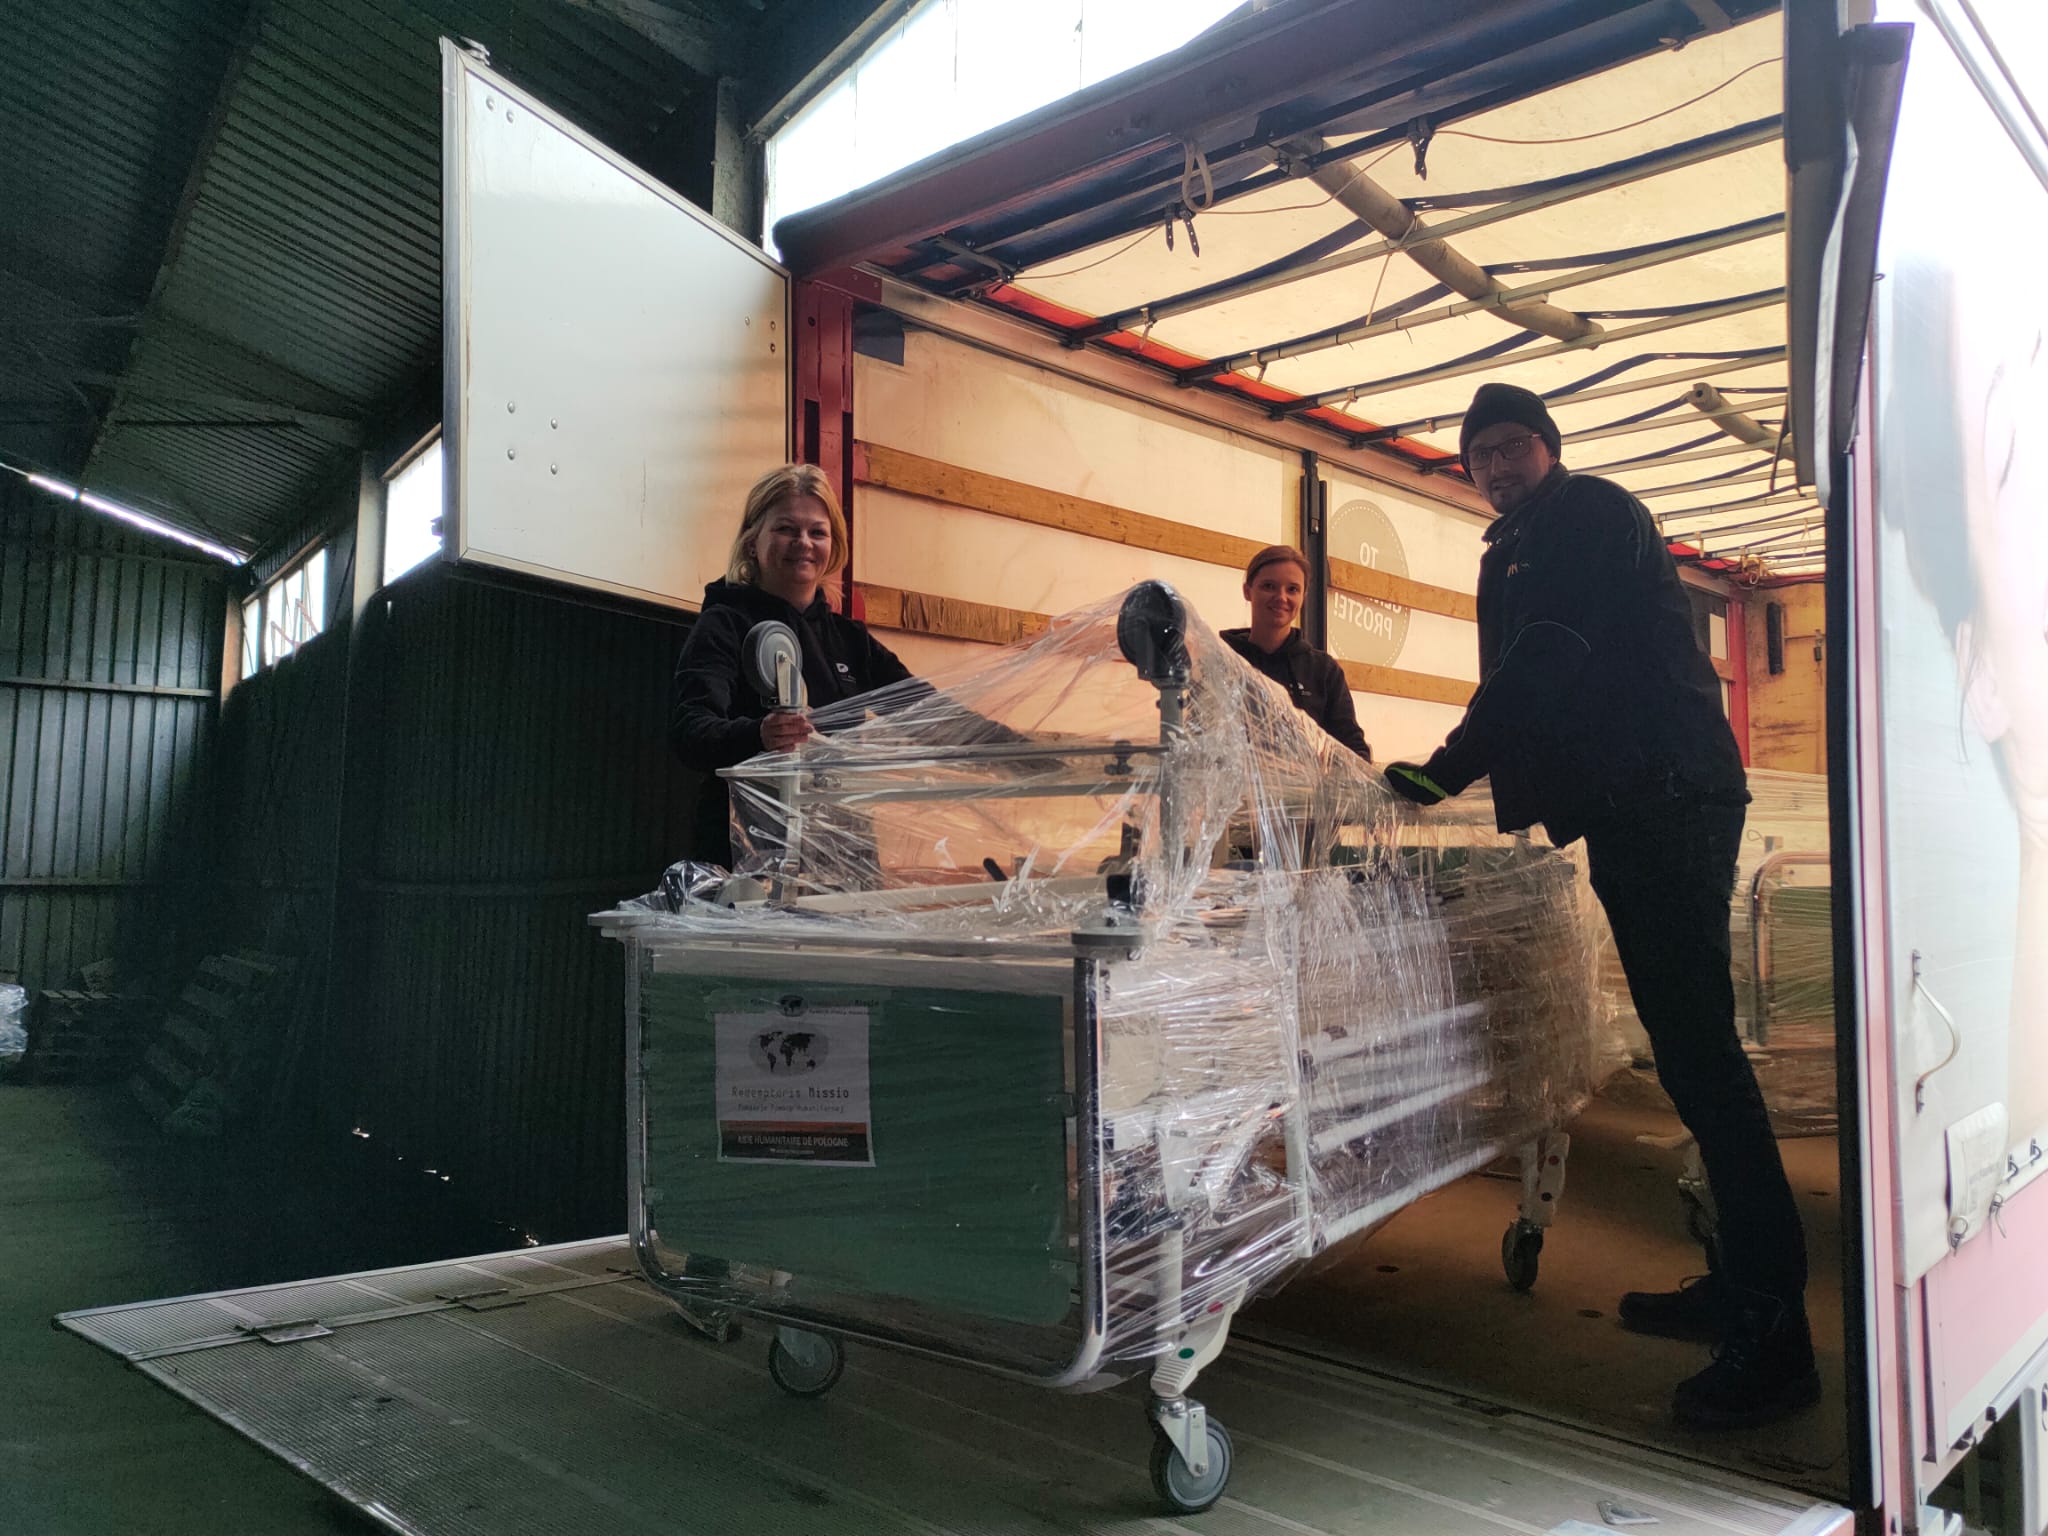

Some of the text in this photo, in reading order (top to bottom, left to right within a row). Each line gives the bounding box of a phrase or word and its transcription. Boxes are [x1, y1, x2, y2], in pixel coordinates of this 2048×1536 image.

[808, 1086, 850, 1099] Missio
[802, 1136, 812, 1146] DE
[813, 1137, 849, 1148] POLOGNE
